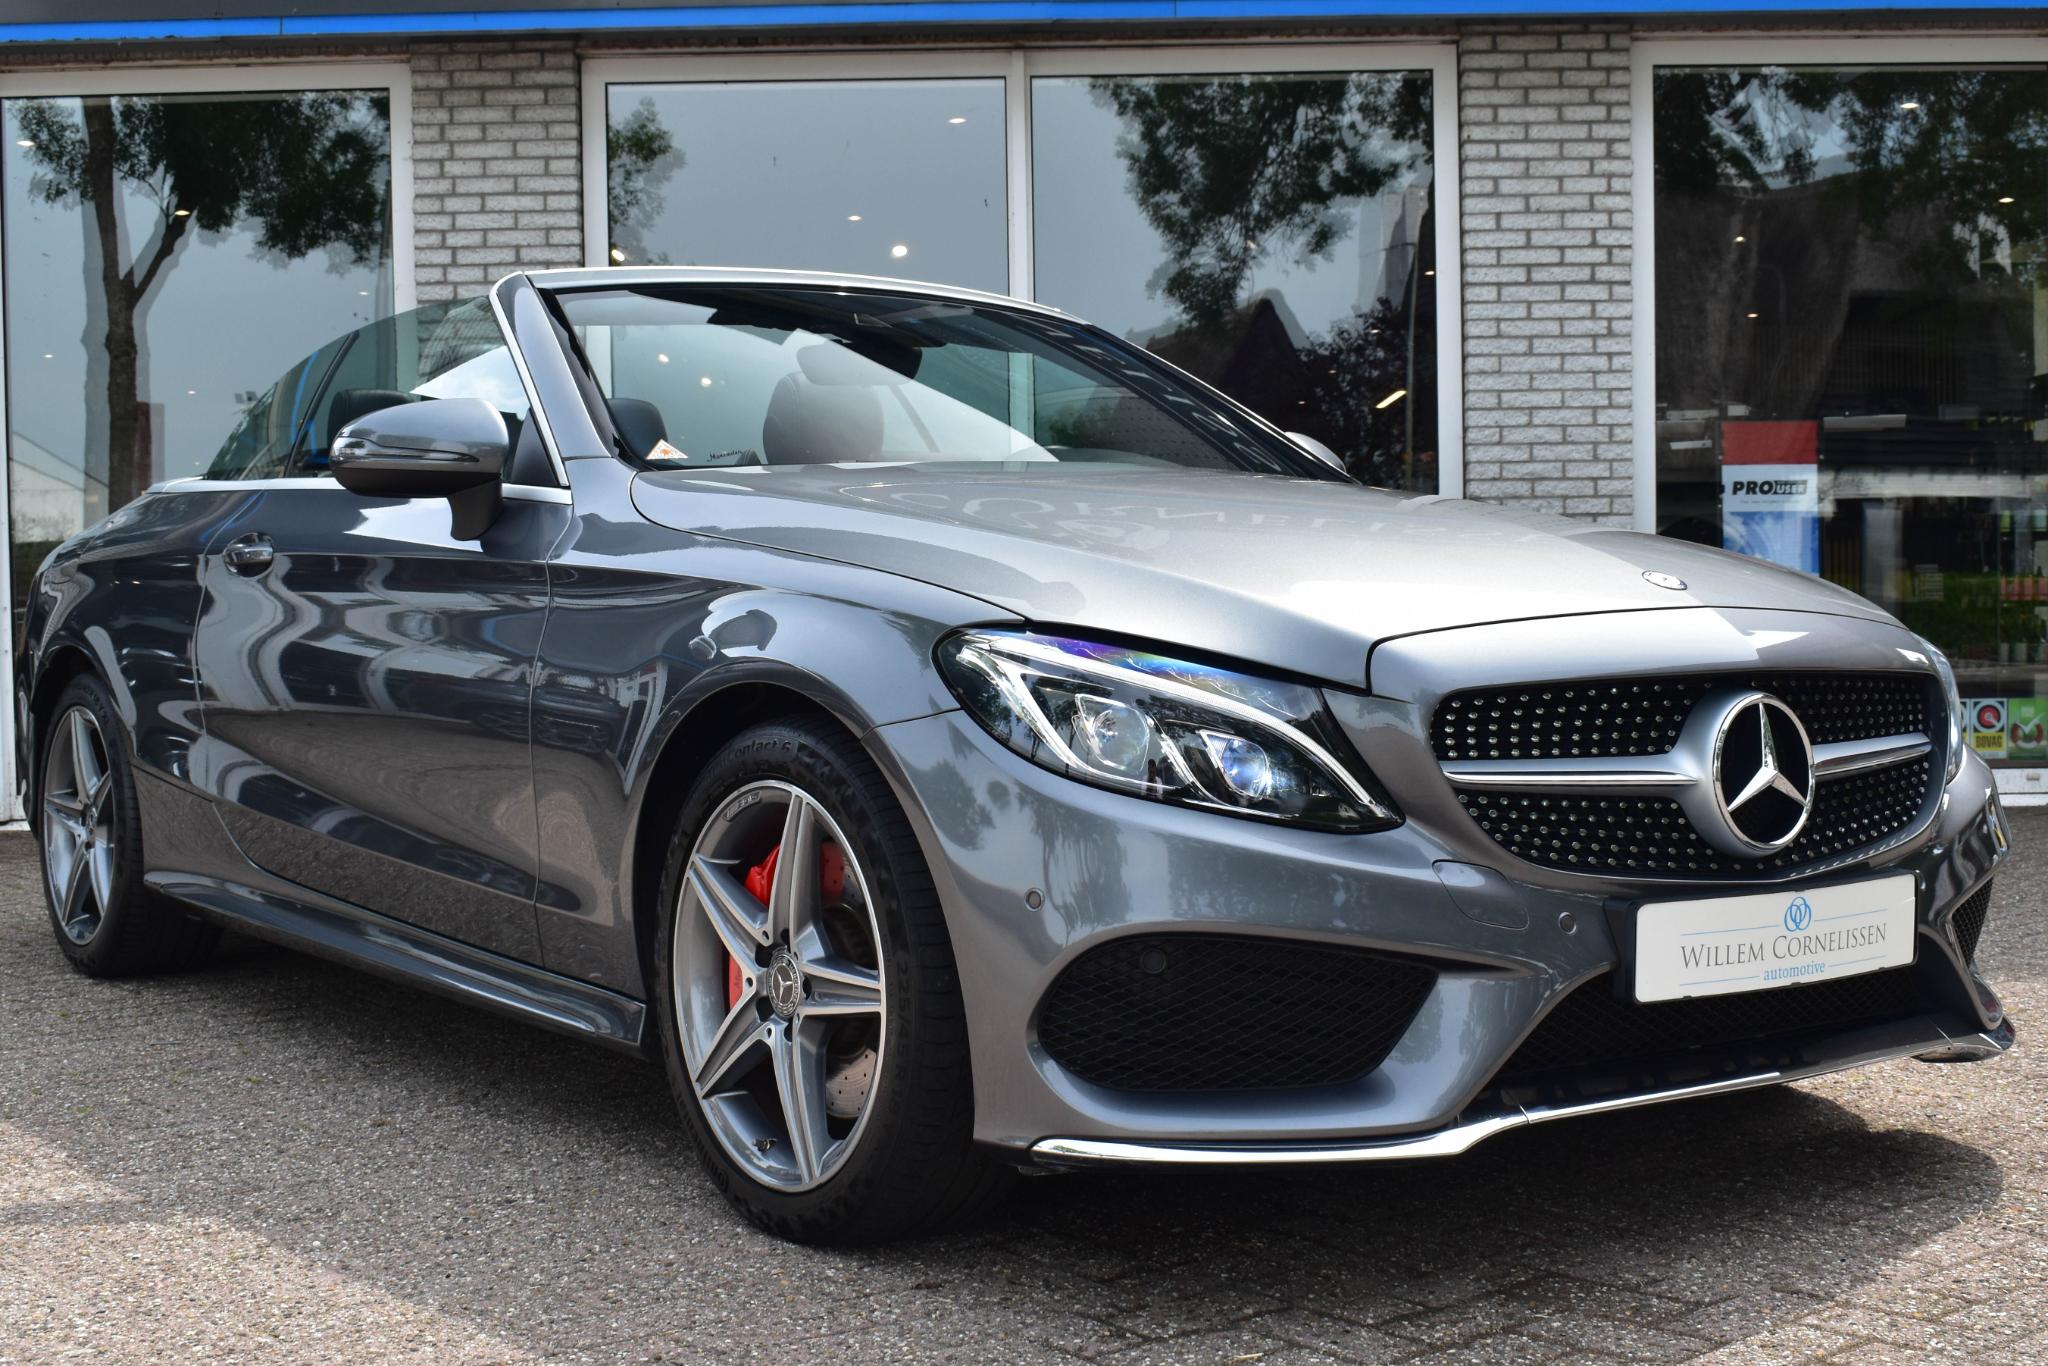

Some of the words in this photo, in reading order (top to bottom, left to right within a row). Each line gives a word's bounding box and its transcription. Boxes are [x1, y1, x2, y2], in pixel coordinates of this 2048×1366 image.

[1975, 735, 2002, 748] BOVAG
[1681, 942, 1764, 968] WILLEM
[1772, 922, 1888, 960] CORNELISSEN
[1763, 961, 1826, 982] automotive
